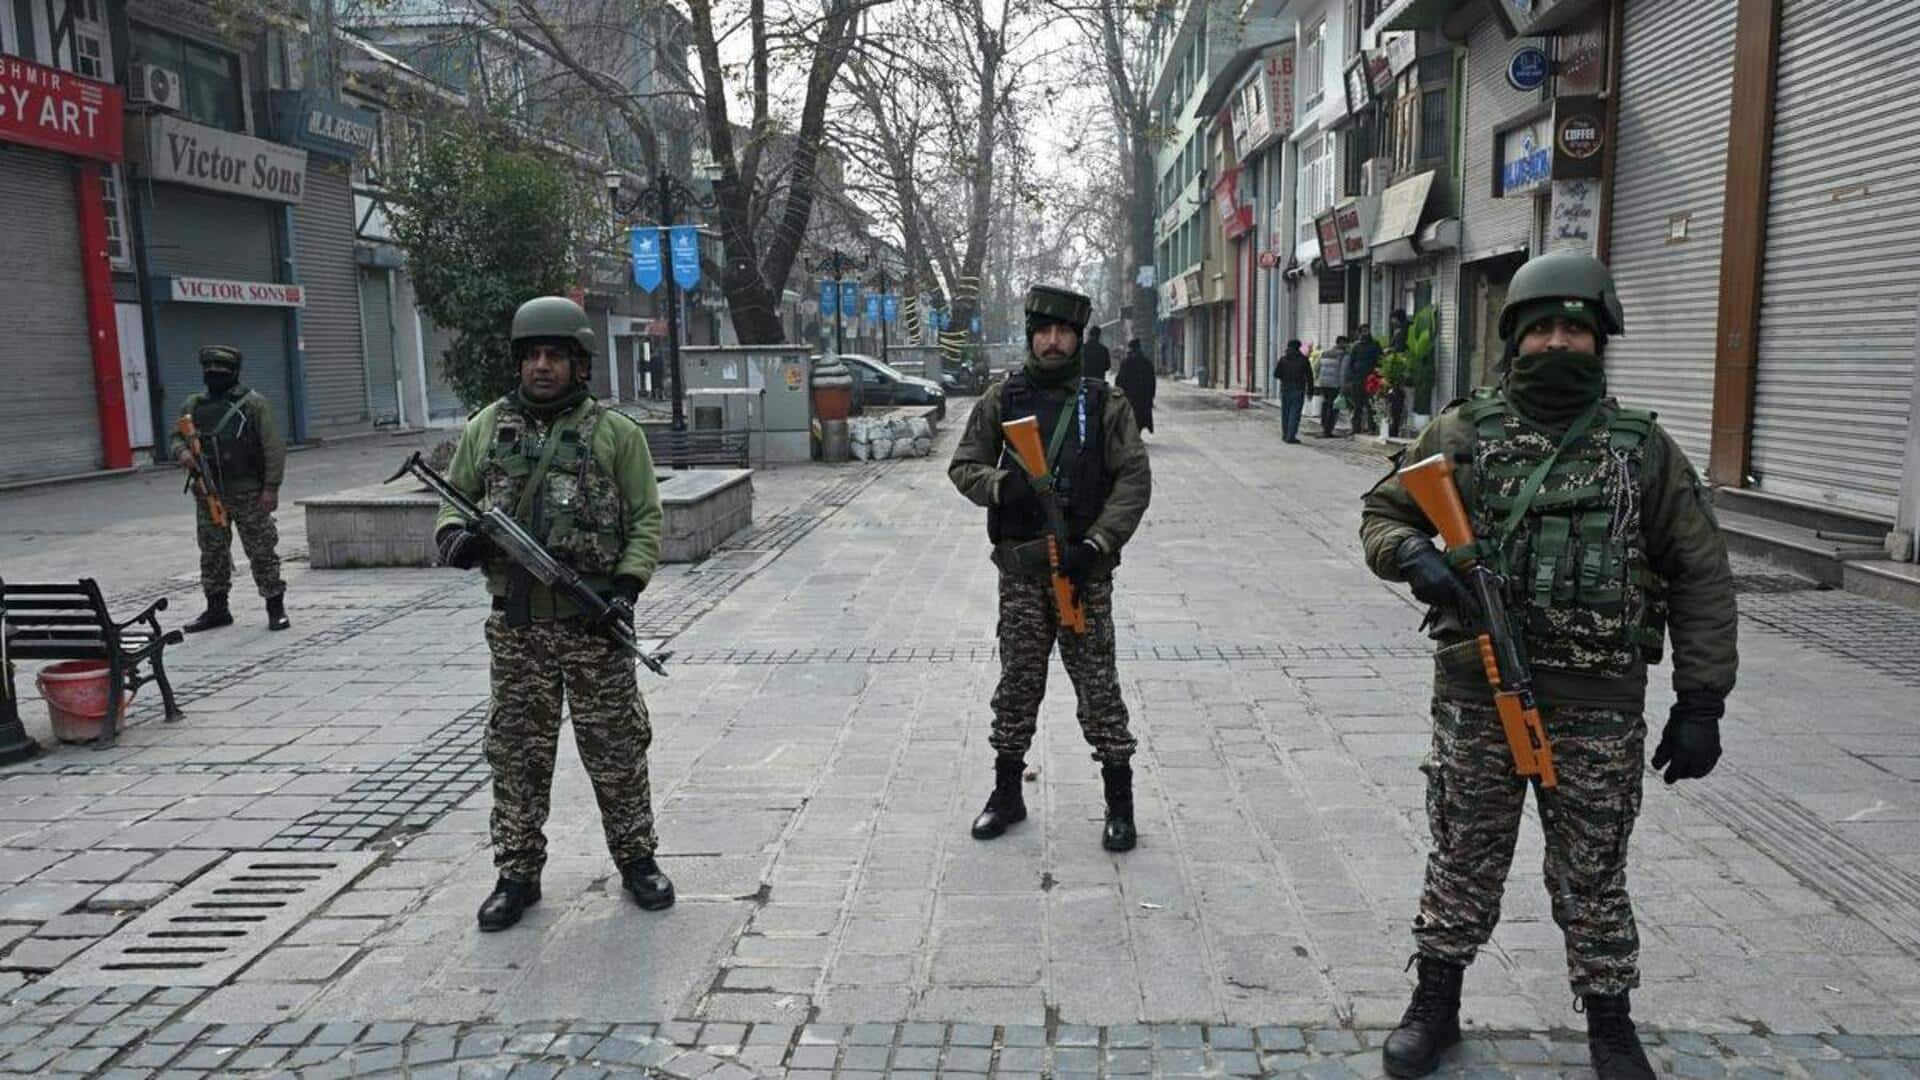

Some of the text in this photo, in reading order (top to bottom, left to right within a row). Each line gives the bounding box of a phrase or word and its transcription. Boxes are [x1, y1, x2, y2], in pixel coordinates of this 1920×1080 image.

[39, 95, 99, 138] ART
[1564, 127, 1595, 141] COFFEE
[167, 133, 302, 196] Victor Sons
[179, 281, 286, 302] VICTOR SONS
